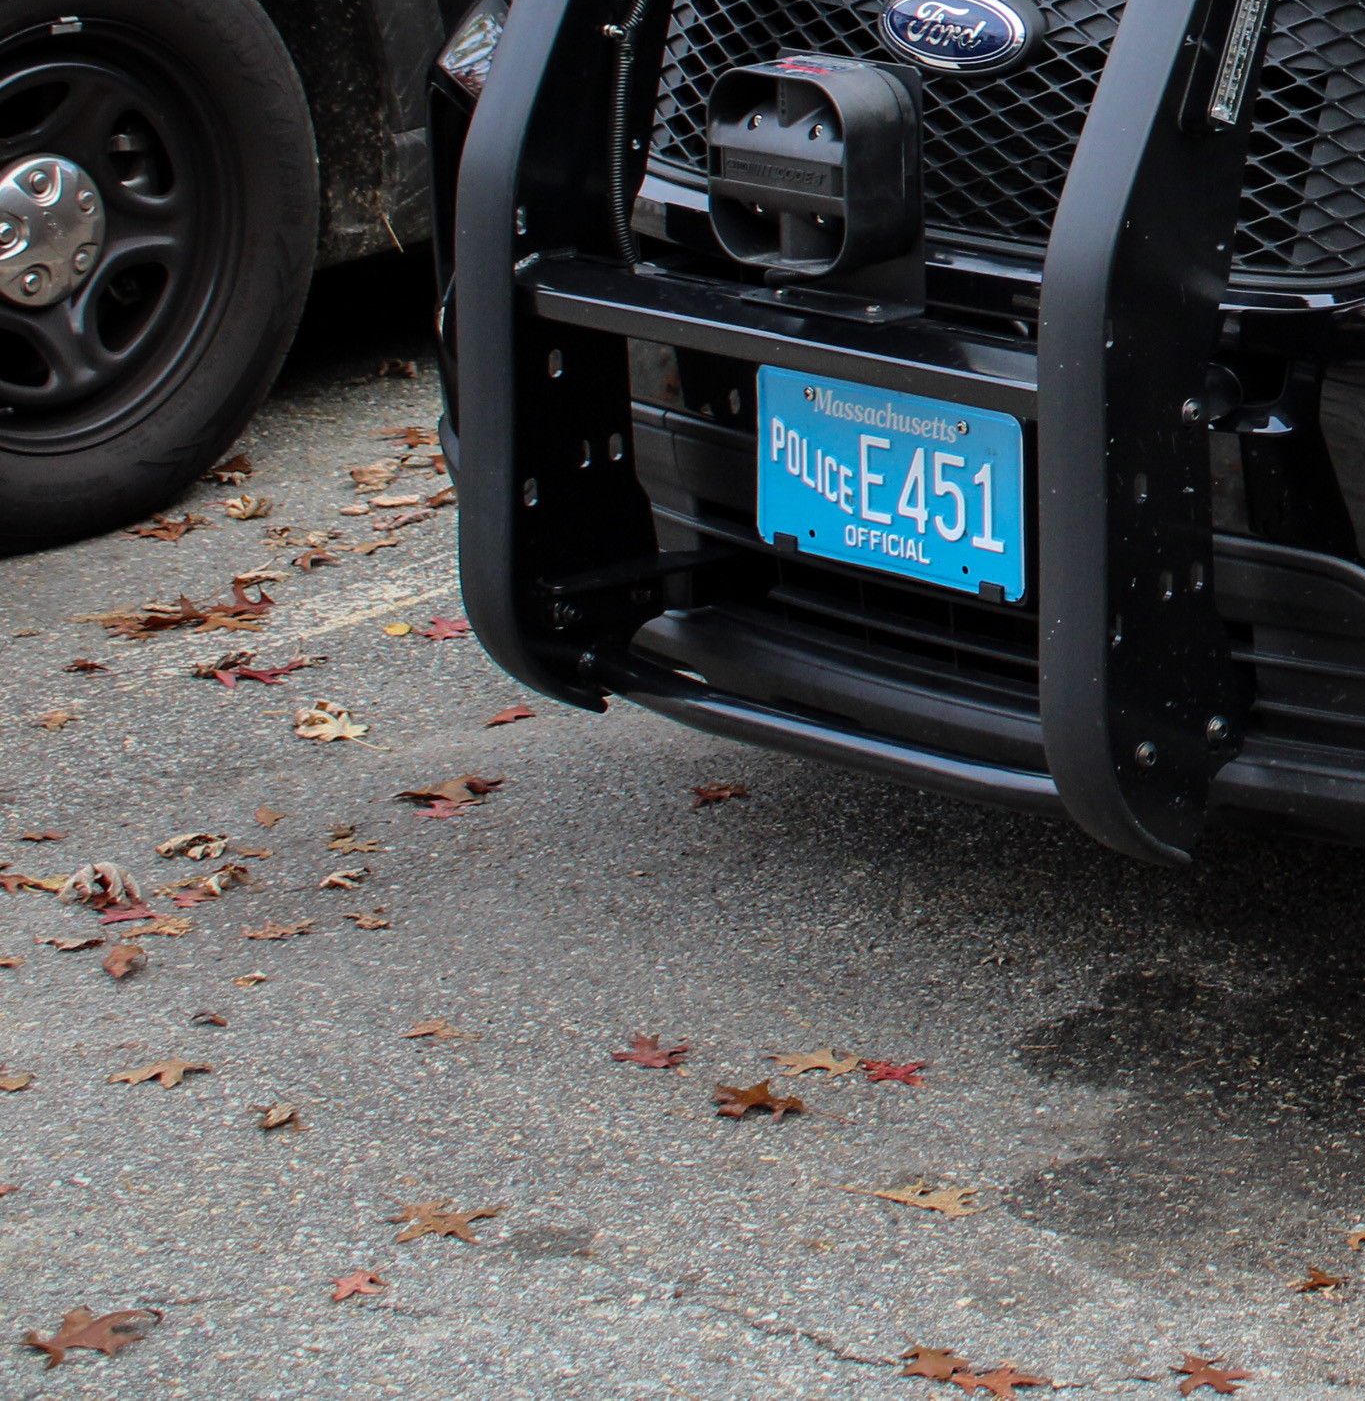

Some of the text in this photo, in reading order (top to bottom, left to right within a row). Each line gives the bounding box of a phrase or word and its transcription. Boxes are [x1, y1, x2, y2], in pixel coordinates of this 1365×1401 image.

[906, 0, 987, 49] Ford
[814, 386, 957, 443] Massachusetts
[771, 416, 1005, 553] POLICE E451
[844, 525, 930, 564] OFFICIAL
